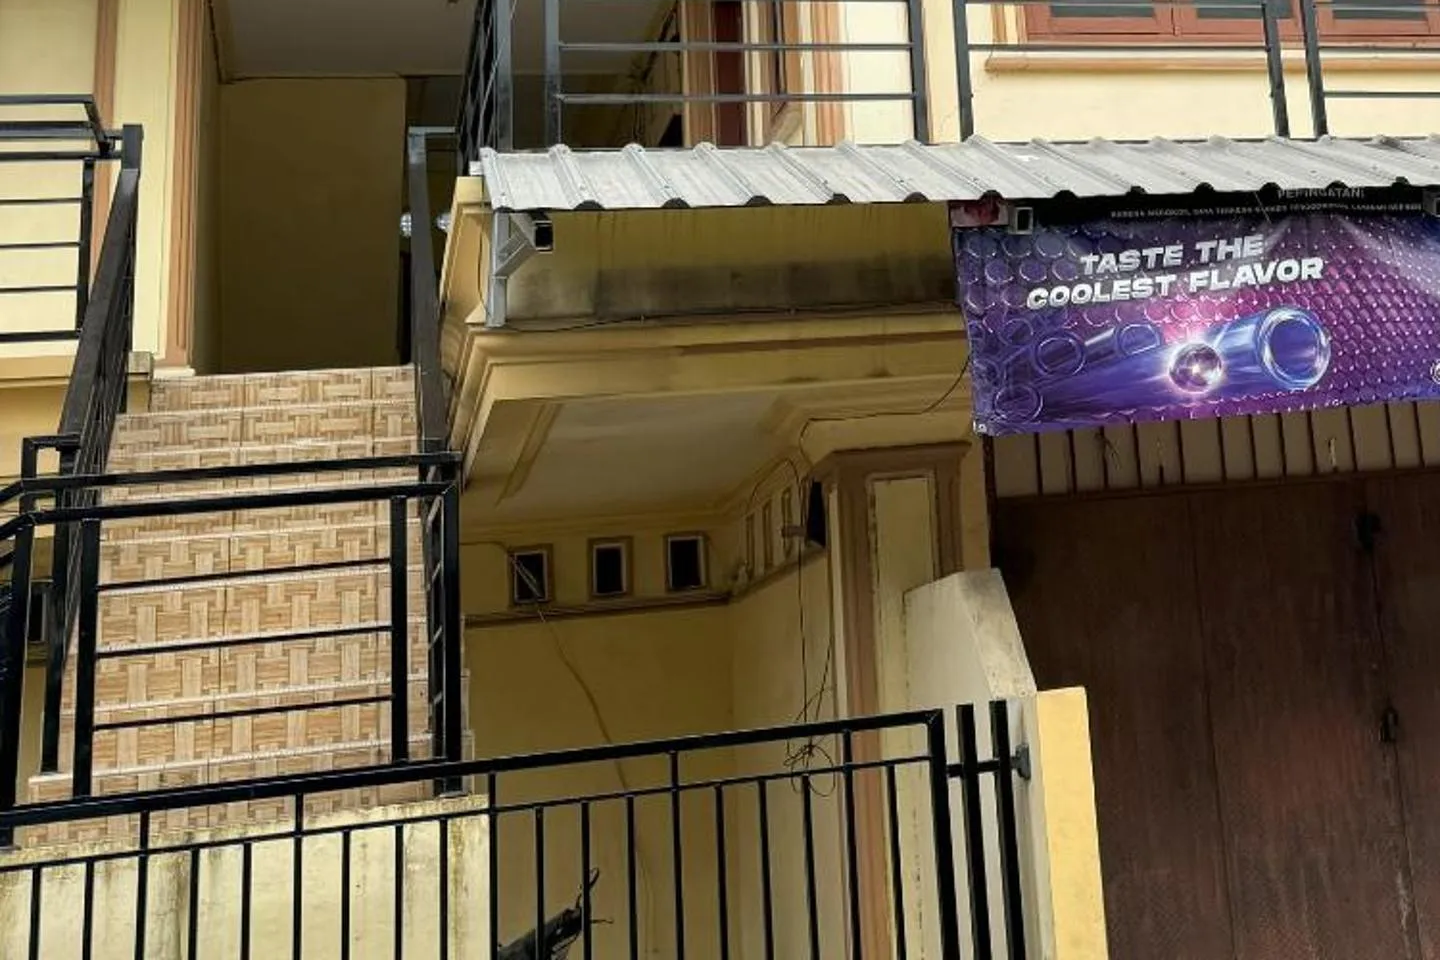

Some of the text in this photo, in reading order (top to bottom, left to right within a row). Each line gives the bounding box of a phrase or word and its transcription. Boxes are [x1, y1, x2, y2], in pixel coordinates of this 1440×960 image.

[1080, 234, 1264, 275] TASTE THE
[1026, 257, 1324, 310] COOLEST FLAVOR
